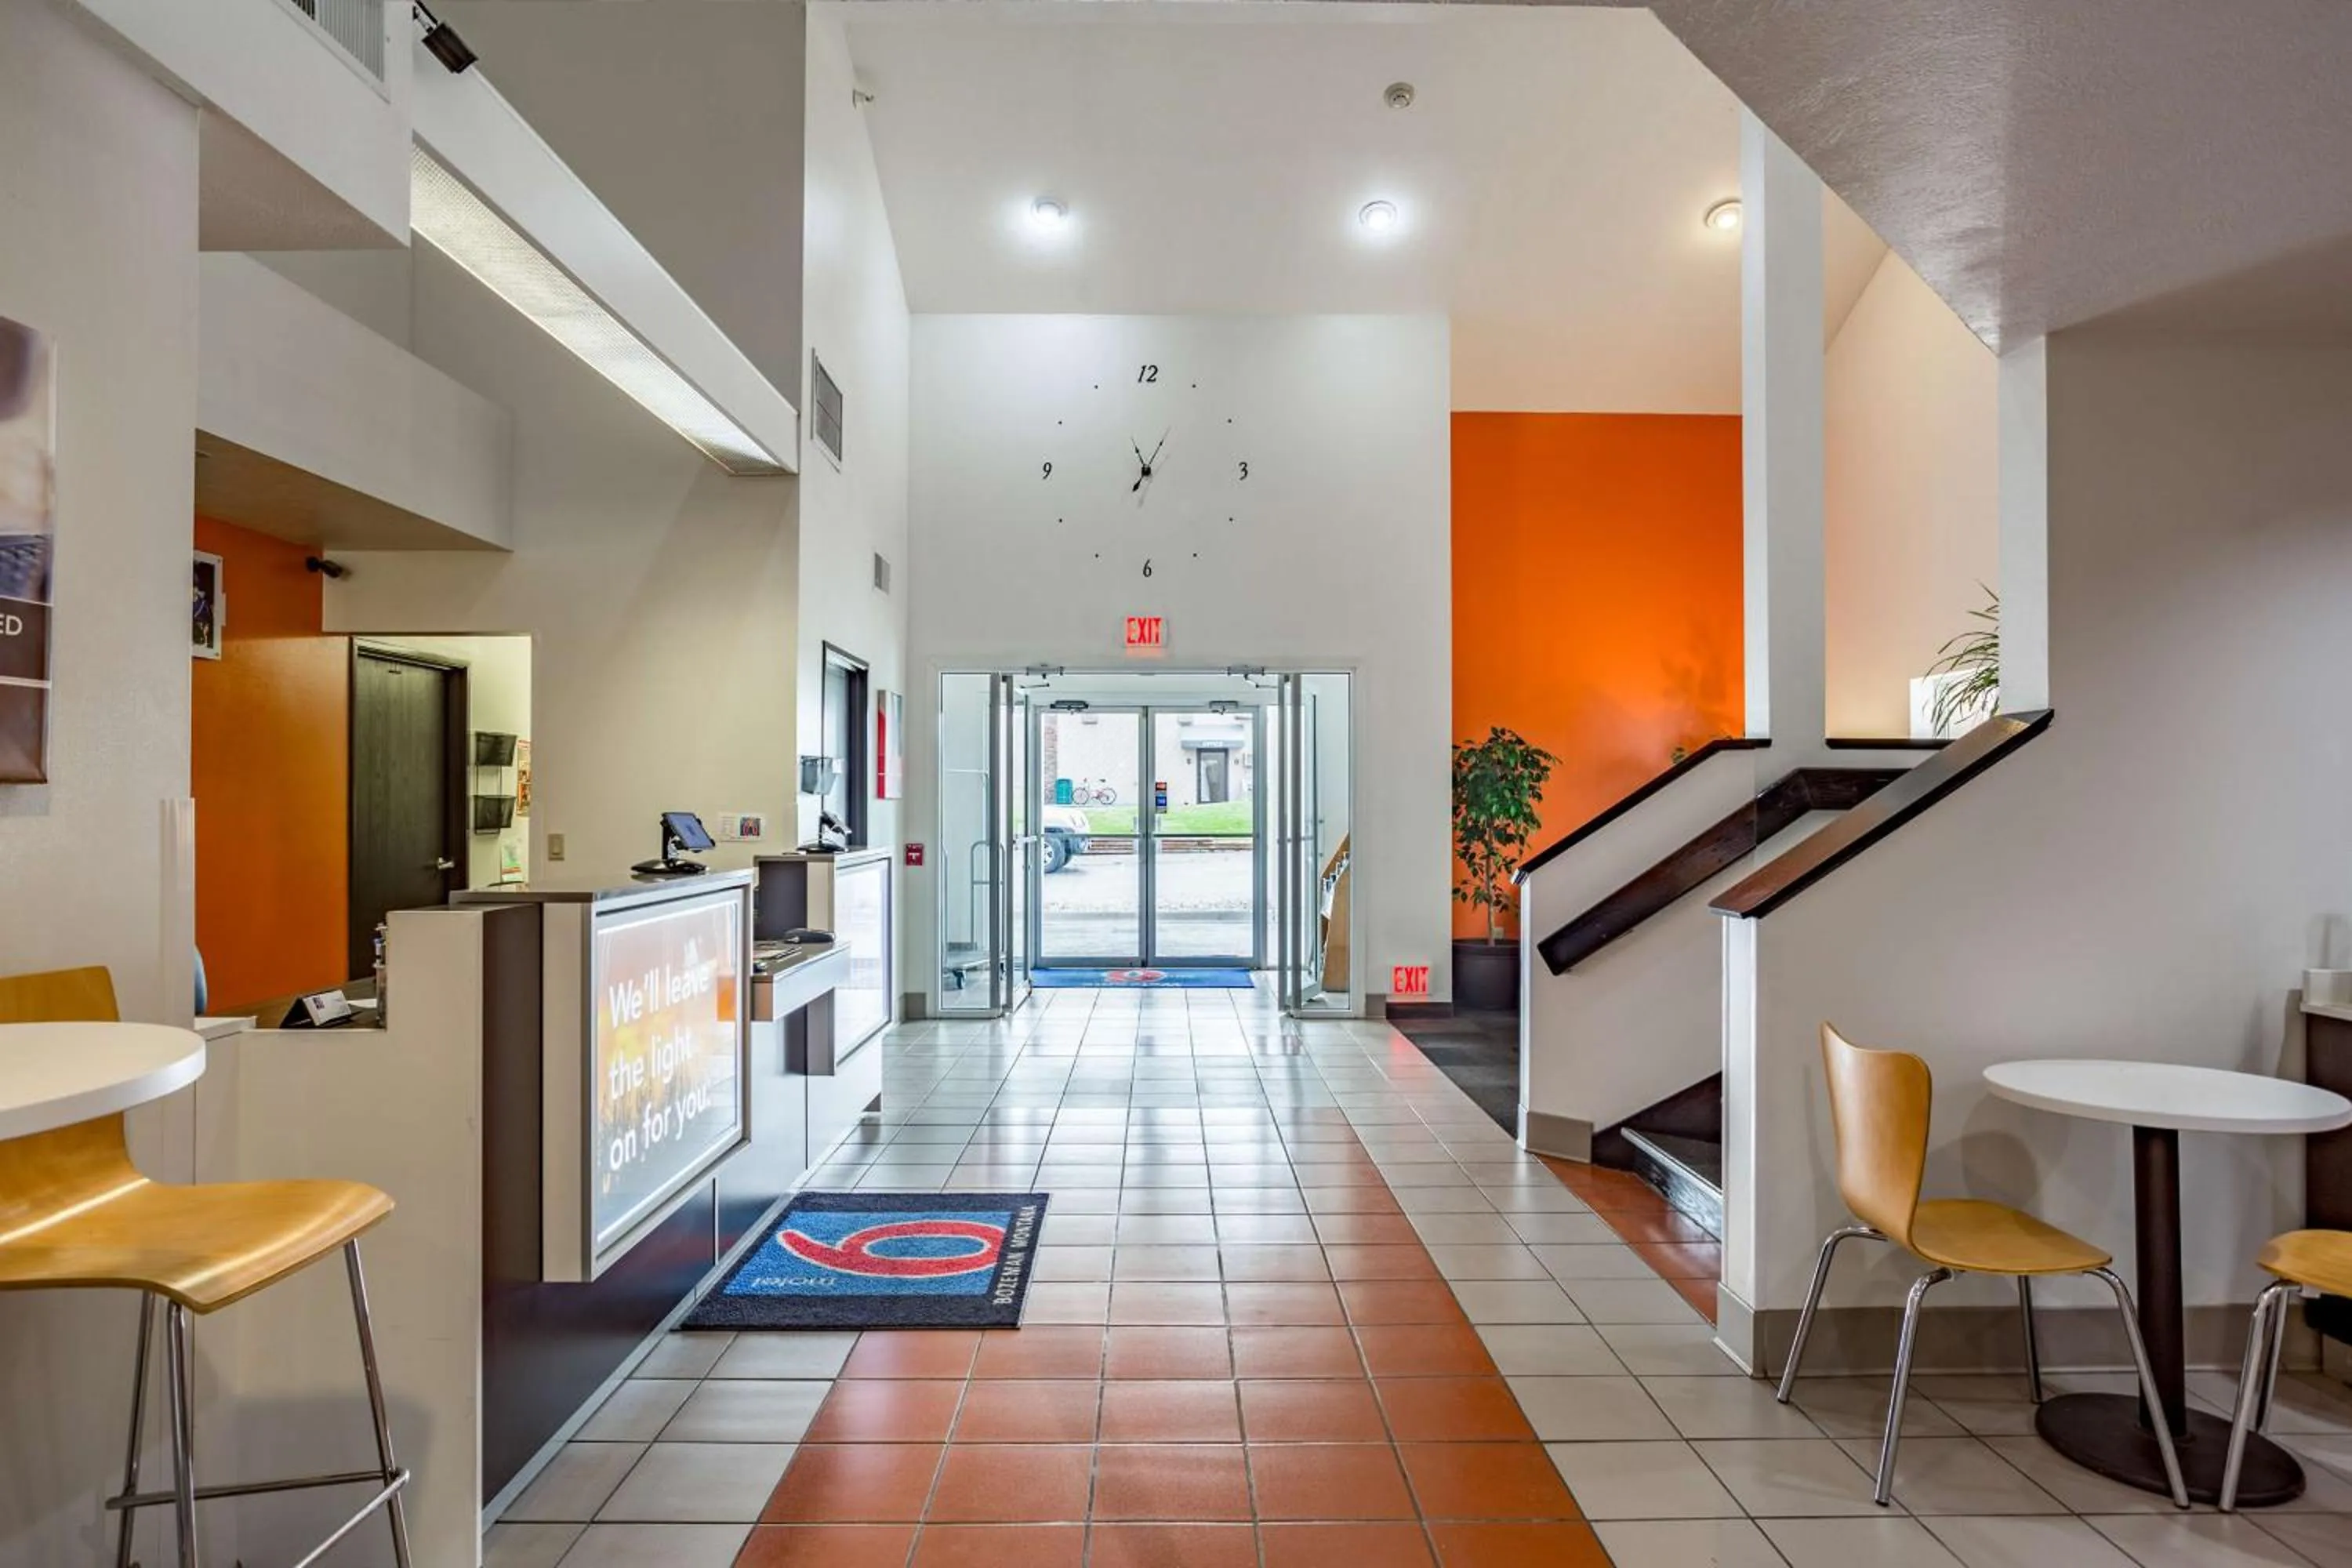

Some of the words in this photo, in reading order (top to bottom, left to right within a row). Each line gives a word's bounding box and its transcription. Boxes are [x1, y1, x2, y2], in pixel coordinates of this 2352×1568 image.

[1138, 365, 1158, 383] 12
[1043, 462, 1052, 479] 9
[1239, 462, 1248, 481] 3
[1142, 559, 1152, 577] 6
[1127, 617, 1161, 644] EXIT
[1395, 966, 1428, 992] EXIT
[609, 966, 659, 1029] We'll
[666, 964, 710, 1007] leave
[609, 1051, 644, 1100] the
[652, 1026, 692, 1084] light
[609, 1126, 637, 1171] on
[643, 1102, 672, 1149] for
[993, 1252, 1025, 1305] BOZEMAN
